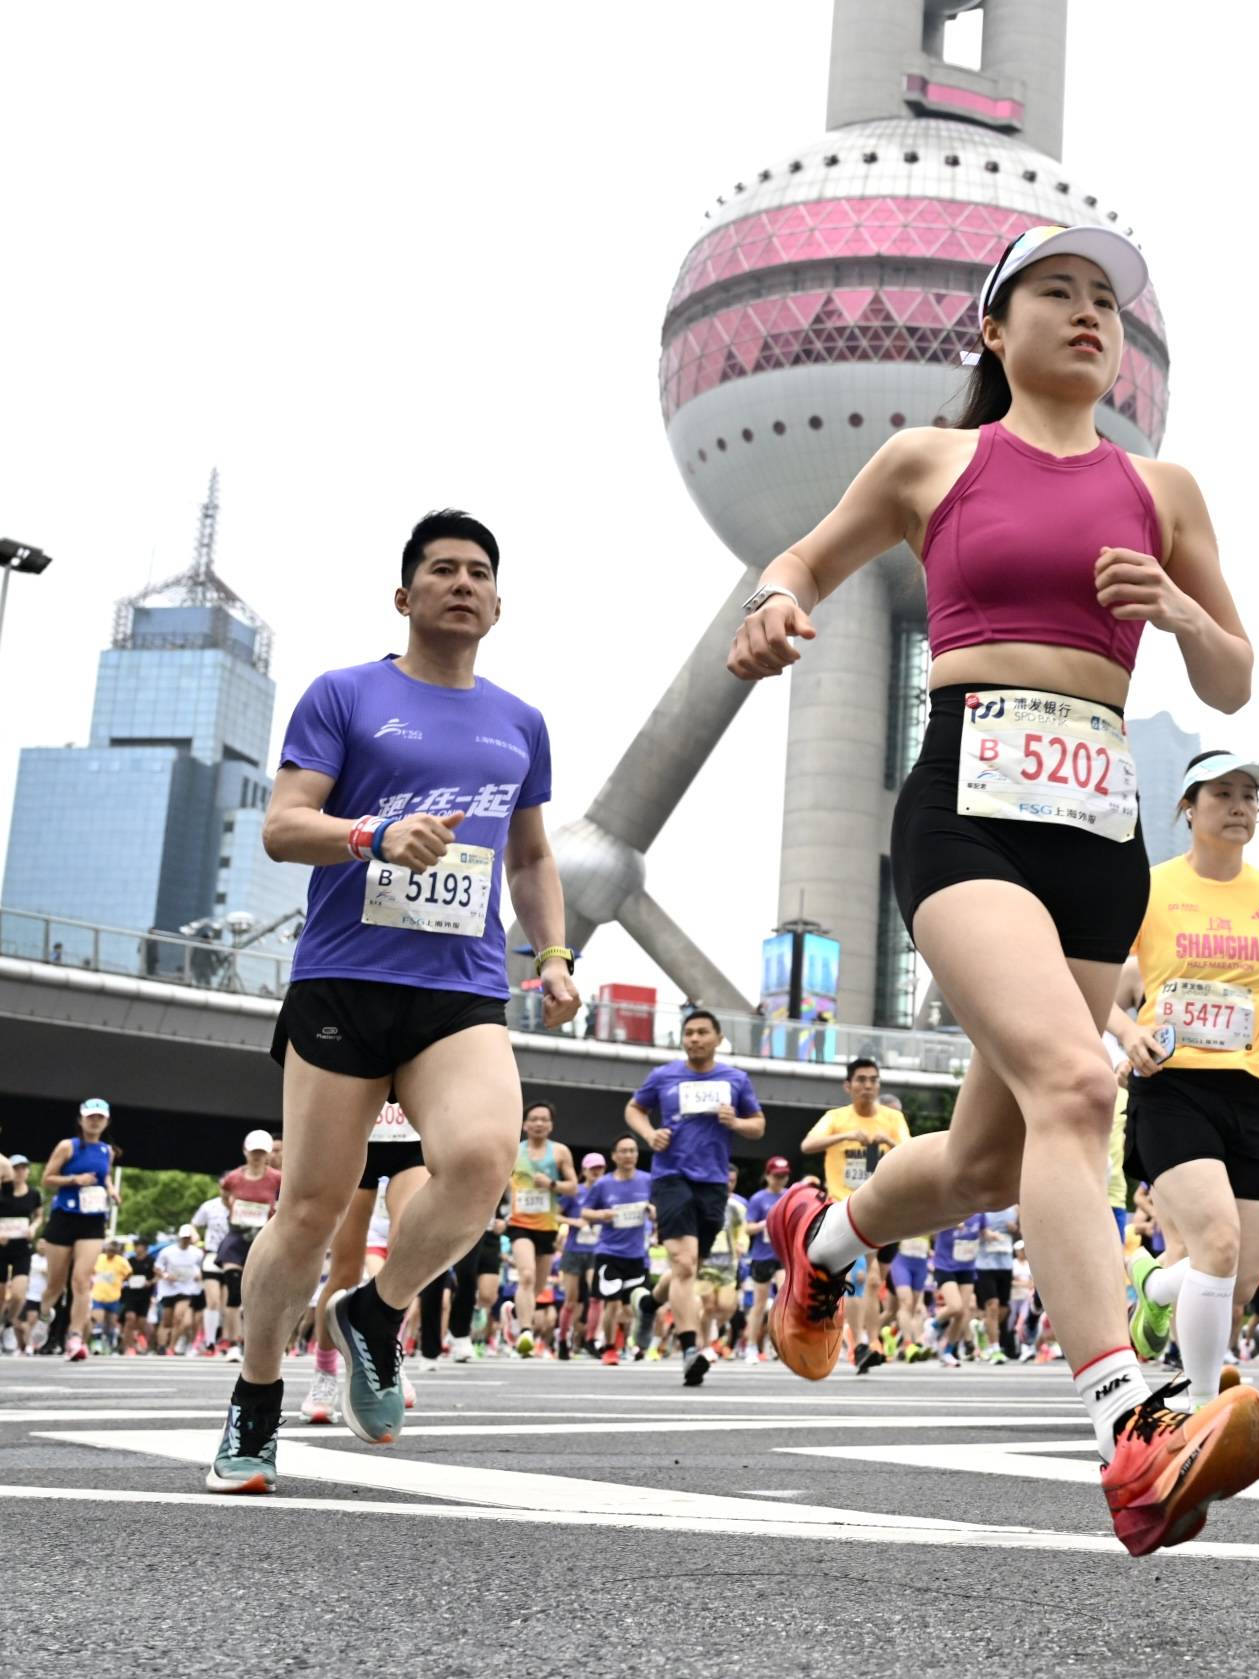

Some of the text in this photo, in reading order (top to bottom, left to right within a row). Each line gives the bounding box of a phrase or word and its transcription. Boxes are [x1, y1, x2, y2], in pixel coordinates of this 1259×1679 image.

[1013, 698, 1072, 718] 浦发银行
[979, 739, 999, 761] B
[1020, 733, 1110, 796] 5202
[1019, 803, 1053, 816] FSG
[1055, 807, 1097, 824] 上海外服
[378, 869, 393, 886] B
[405, 871, 472, 907] 5193
[1163, 1002, 1235, 1030] B 5477
